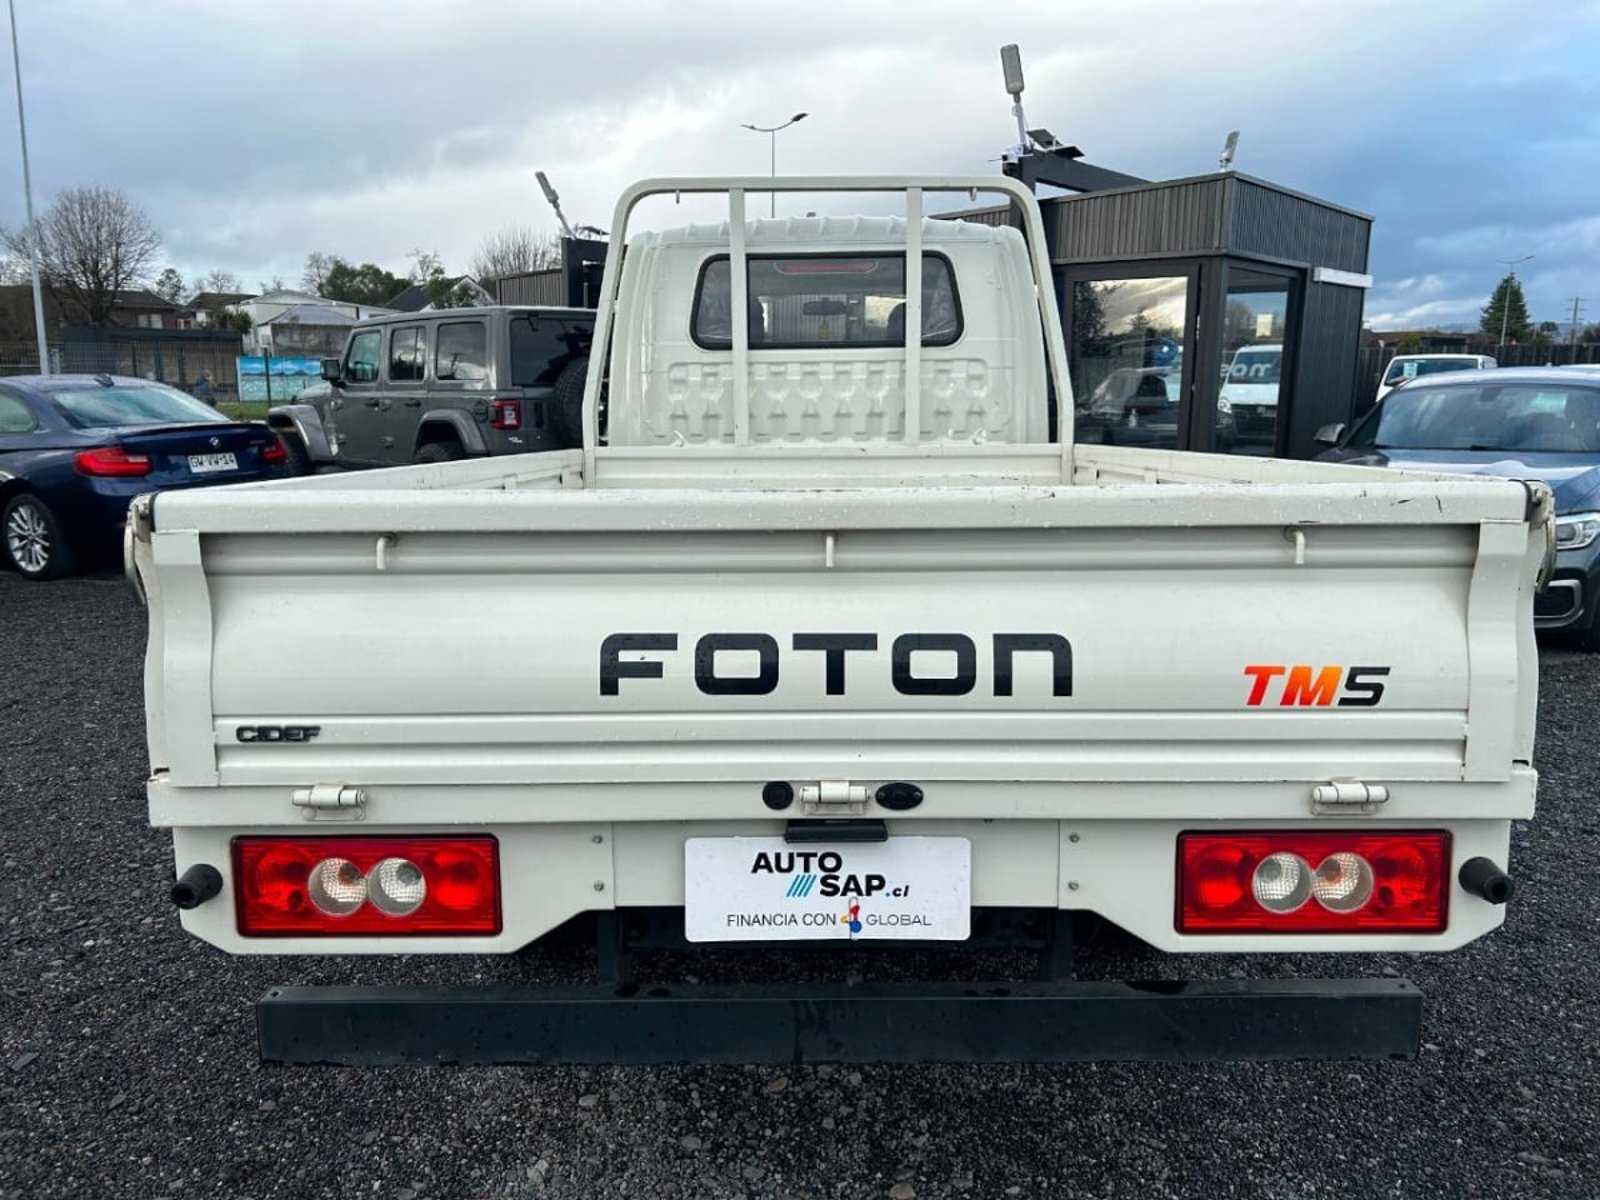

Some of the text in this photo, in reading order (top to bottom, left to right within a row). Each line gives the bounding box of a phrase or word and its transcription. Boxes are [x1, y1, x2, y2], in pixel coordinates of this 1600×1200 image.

[600, 633, 1073, 696] FOTON
[1244, 666, 1391, 706] TM5
[751, 851, 843, 873] AUTO
[726, 913, 932, 927] FINANCIA CON GLOBAL
